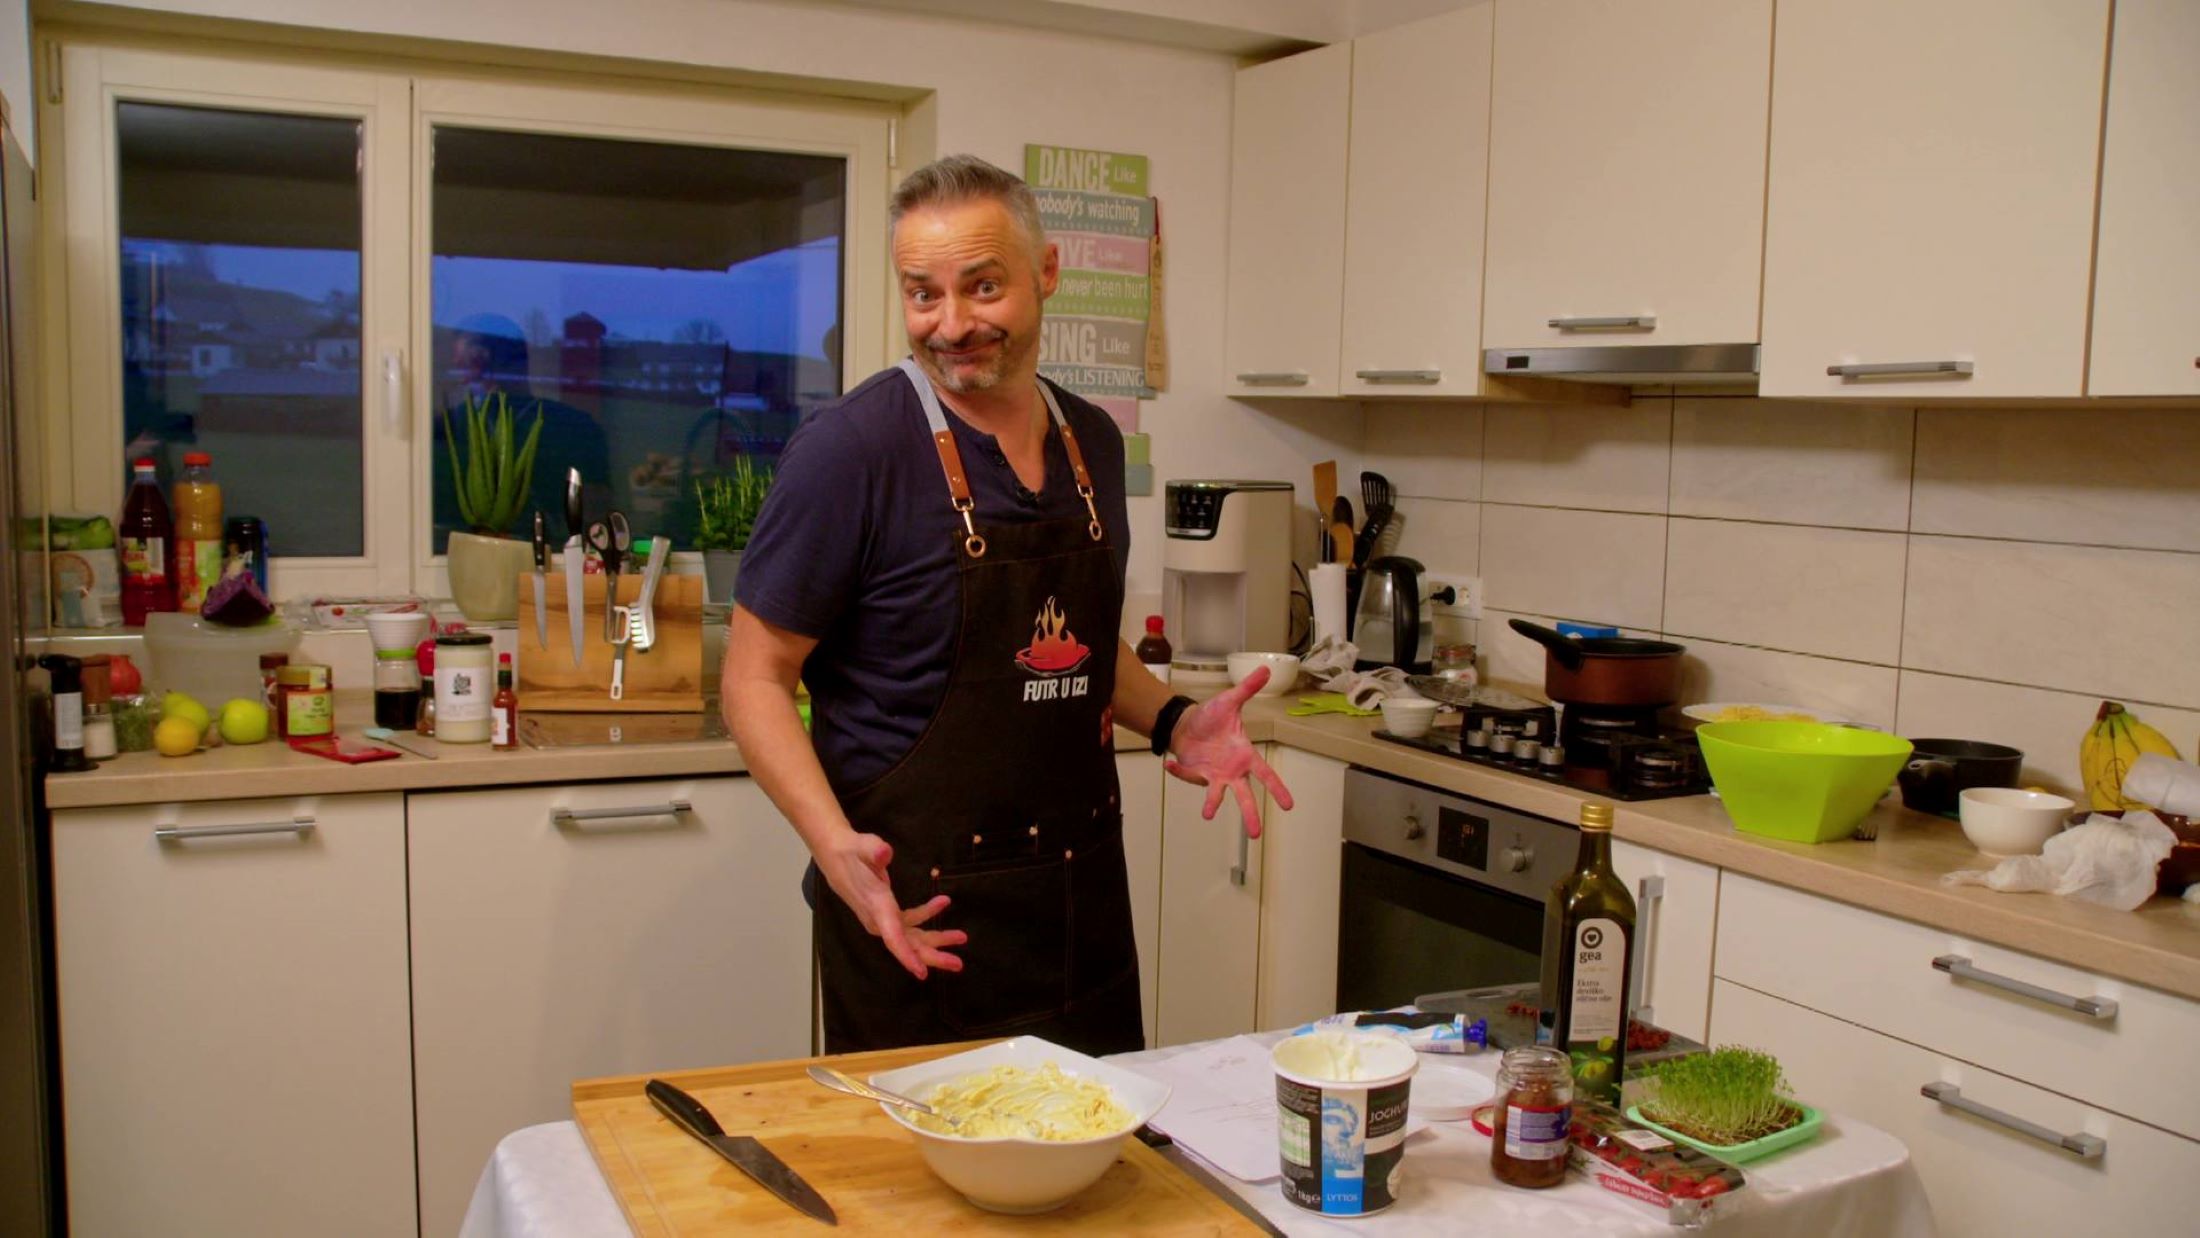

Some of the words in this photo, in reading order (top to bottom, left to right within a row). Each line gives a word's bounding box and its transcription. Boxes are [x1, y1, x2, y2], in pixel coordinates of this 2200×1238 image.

[1039, 148, 1111, 192] DANCE
[1114, 166, 1137, 183] Like
[1088, 200, 1140, 227] watching
[1062, 277, 1093, 297] never
[1094, 276, 1121, 297] been
[1124, 277, 1149, 299] hurt
[1040, 322, 1097, 364] SING
[1102, 337, 1131, 355] Like
[1075, 368, 1145, 387] LISTENING
[1023, 679, 1059, 702] FUTR
[1061, 677, 1071, 699] U
[1072, 676, 1089, 697] IZI
[1579, 951, 1602, 964] gea
